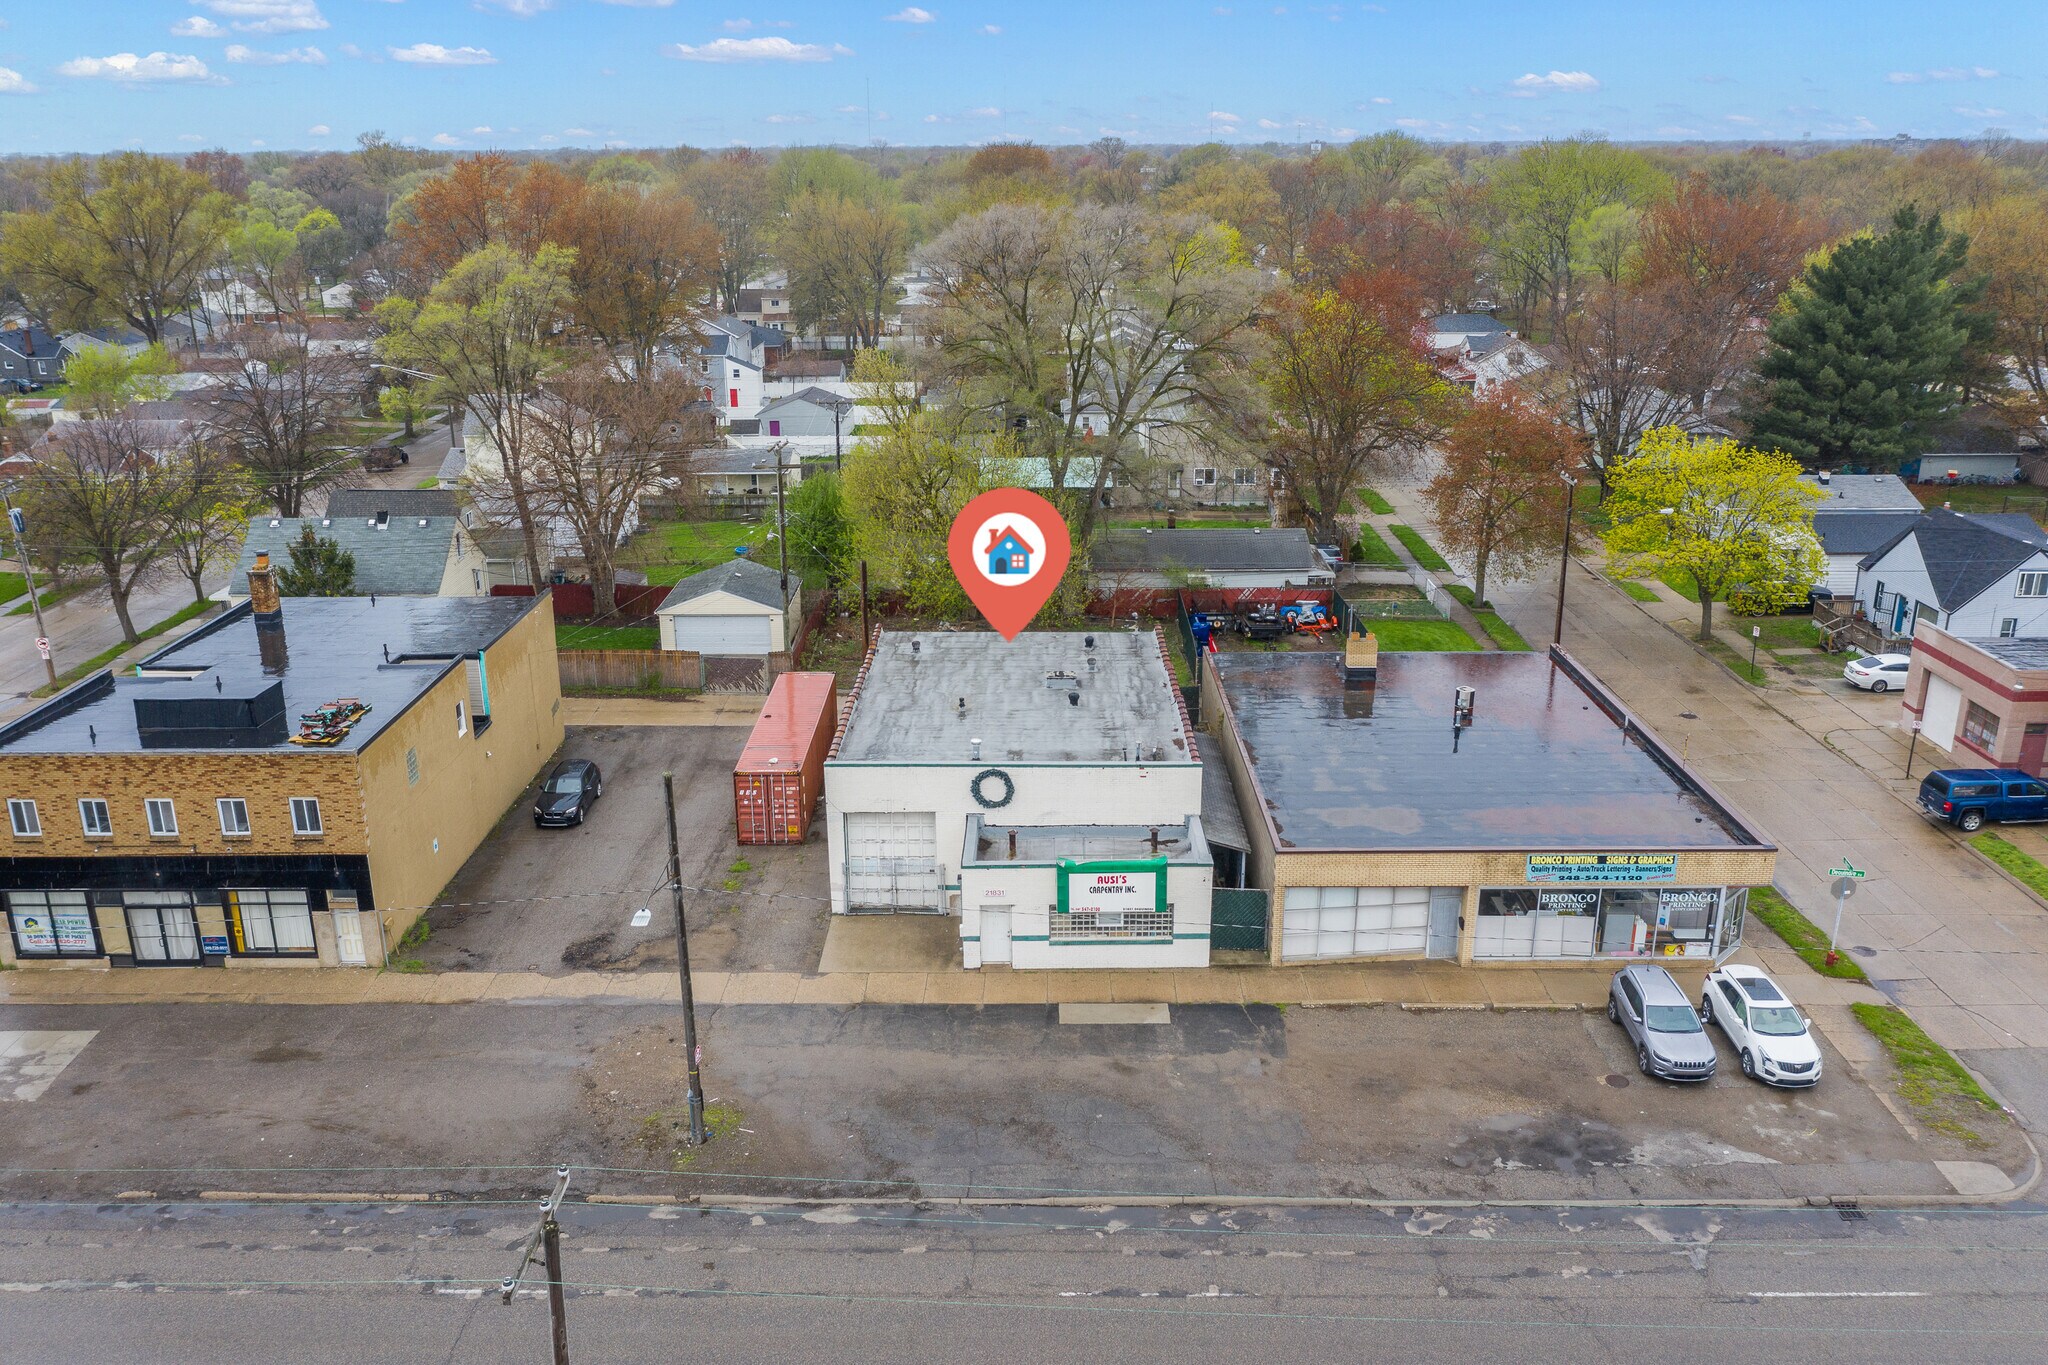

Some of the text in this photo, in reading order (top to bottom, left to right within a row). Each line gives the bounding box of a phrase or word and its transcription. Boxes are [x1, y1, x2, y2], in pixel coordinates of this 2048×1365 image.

[1531, 855, 1674, 864] BRONCO PRINTING SIGNS & GRAPHICS
[1531, 865, 1550, 873] Quality
[1551, 865, 1572, 873] Printing
[1607, 865, 1631, 873] Lettering
[1089, 886, 1123, 894] CARPENTRY
[1541, 893, 1597, 902] BRONCO
[1661, 893, 1716, 902] BRONCO
